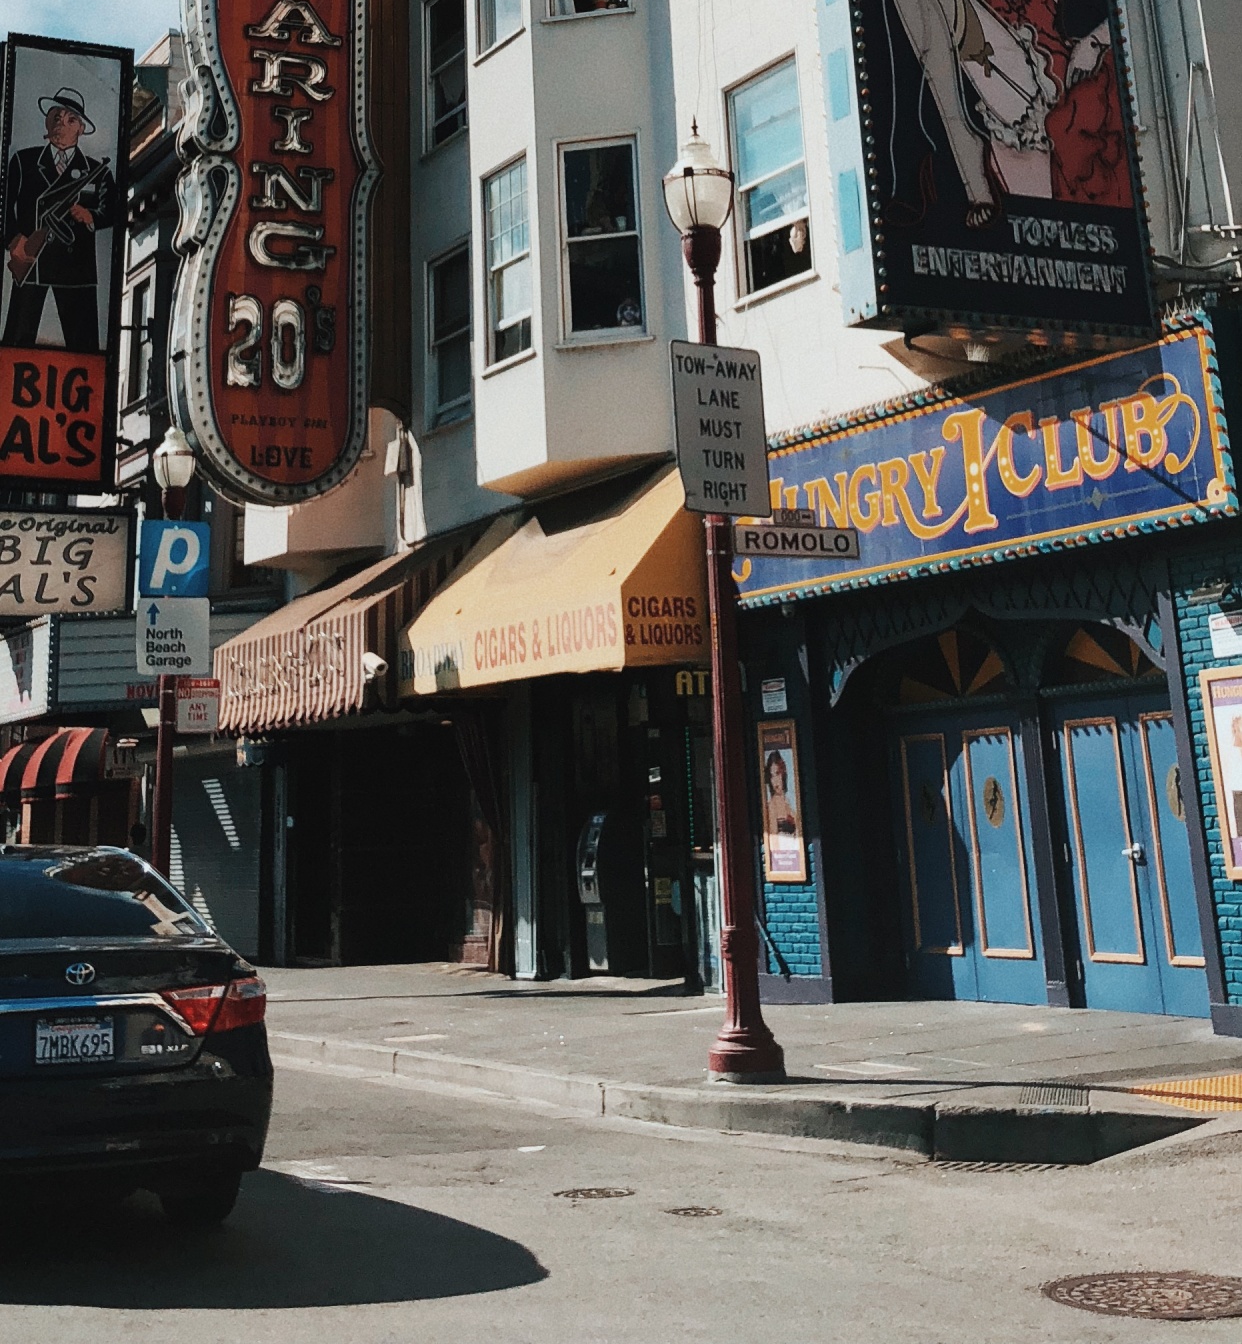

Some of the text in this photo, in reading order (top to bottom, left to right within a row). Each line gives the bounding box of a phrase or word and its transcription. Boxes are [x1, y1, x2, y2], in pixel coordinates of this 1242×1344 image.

[1007, 213, 1119, 255] TOPLESS
[911, 244, 1129, 295] ENTERTAINMENT
[675, 354, 757, 381] TOW-AWAY
[12, 361, 94, 414] BIG
[697, 387, 740, 409] LANE
[0, 411, 97, 467] AL'S
[700, 418, 742, 439] MUST
[250, 445, 313, 469] LOVE
[702, 449, 745, 470] TURN
[735, 446, 948, 540] UNGRY
[997, 372, 1202, 498] CLUB
[703, 480, 748, 502] RIGHT
[18, 516, 120, 538] Original
[0, 534, 95, 571] BIG
[744, 530, 850, 554] ROMOLO
[0, 571, 98, 607] AL'S
[627, 596, 697, 618] CIGARS
[145, 627, 183, 640] North
[473, 621, 527, 670] CIGARS
[532, 619, 543, 662] &
[547, 602, 618, 657] LIQUORS
[625, 622, 703, 646] & LIQUORS
[145, 641, 187, 654] Beach
[145, 654, 192, 668] Garage
[178, 687, 191, 698] NO
[675, 670, 710, 696] AT
[187, 712, 209, 721] TIME
[188, 703, 208, 712] ANY
[40, 1033, 111, 1058] 7MBK695
